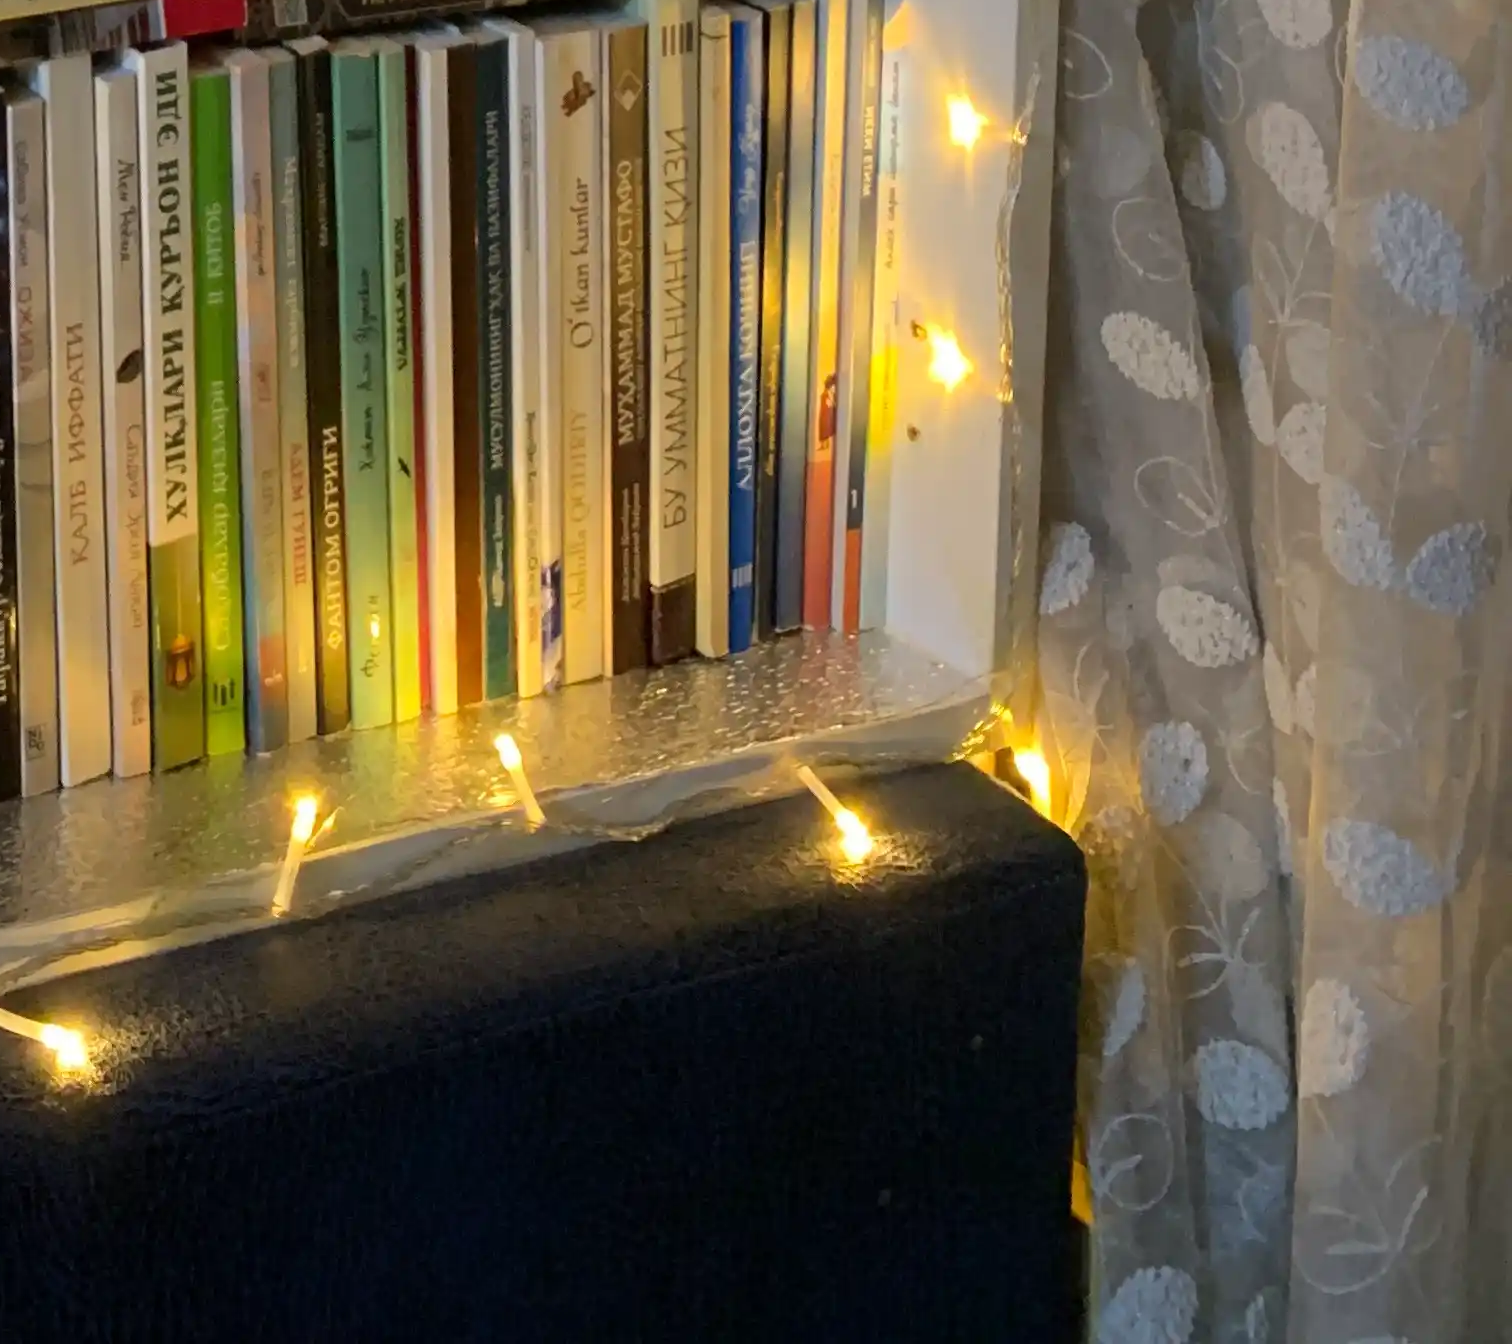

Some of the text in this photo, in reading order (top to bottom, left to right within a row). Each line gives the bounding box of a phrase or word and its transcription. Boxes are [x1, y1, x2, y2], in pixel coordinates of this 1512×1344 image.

[570, 177, 589, 257] kunlar
[155, 68, 190, 524] ХУЛҚЛАРИ ҚУРЪОН ЭДИ
[662, 242, 689, 478] УММАТНИНГ
[65, 321, 87, 464] ИФФАТИ
[662, 488, 688, 529] БУ
[324, 534, 343, 650] ФАНТОМ
